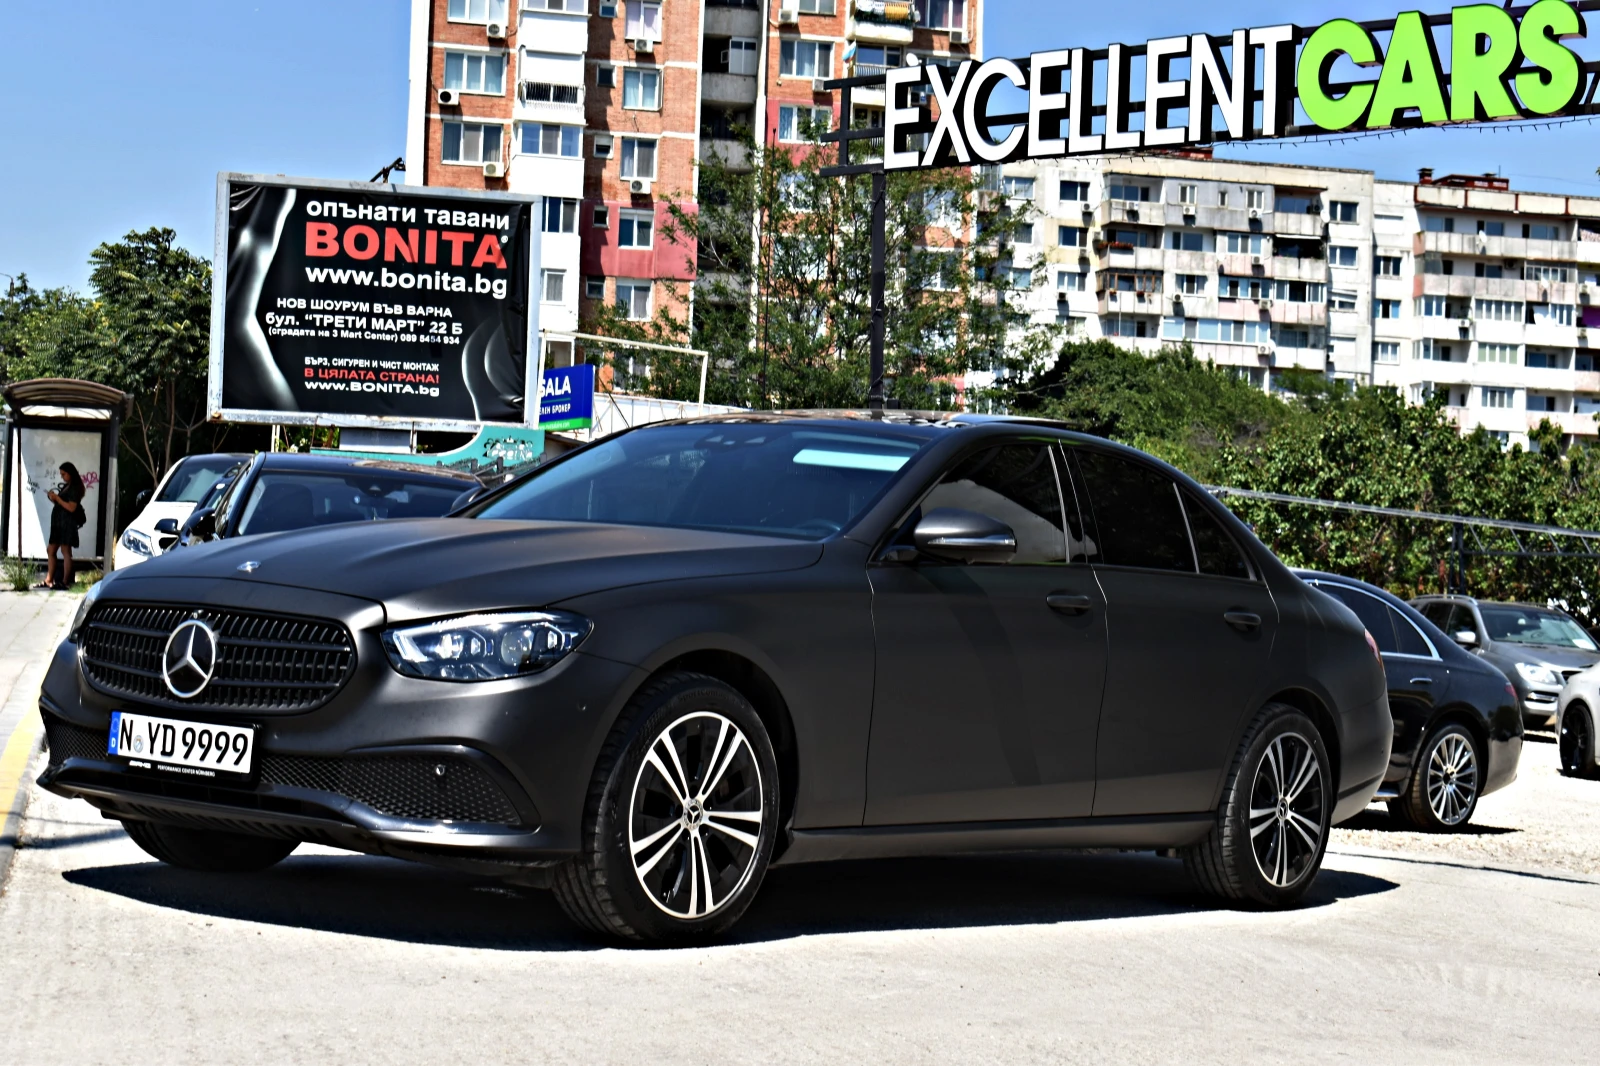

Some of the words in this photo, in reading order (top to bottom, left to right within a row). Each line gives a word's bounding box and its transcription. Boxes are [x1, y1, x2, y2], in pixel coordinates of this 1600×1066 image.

[883, 24, 1293, 169] EXCELLENT
[1297, 0, 1578, 130] CARS
[306, 200, 416, 223] опънати
[424, 208, 510, 230] тавани
[305, 221, 508, 269] BONITA
[305, 267, 507, 300] www.bonita.bg
[277, 297, 307, 309] НОВ
[310, 298, 370, 313] ШОУРУМ
[373, 303, 403, 315] ВЪВ
[406, 305, 453, 318] ВАРНА
[265, 312, 300, 328] бул.
[429, 321, 447, 334] 22
[451, 322, 463, 335] Б
[332, 329, 338, 338] 3
[340, 330, 362, 339] Mart
[364, 331, 398, 343] Center)
[304, 356, 330, 367] БЪРЗ,
[332, 357, 370, 368] СИГУРЕН
[372, 360, 378, 368] И
[380, 360, 402, 370] ЧИСТ
[403, 362, 439, 372] МОНТАЖ
[304, 368, 314, 378] В
[319, 368, 376, 380] ЦЯЛАТА
[379, 371, 439, 384] СТРАНА!
[304, 381, 440, 397] www.BONITA.bg
[119, 718, 134, 752] N
[148, 722, 176, 757] YD
[181, 727, 248, 766] 9999
